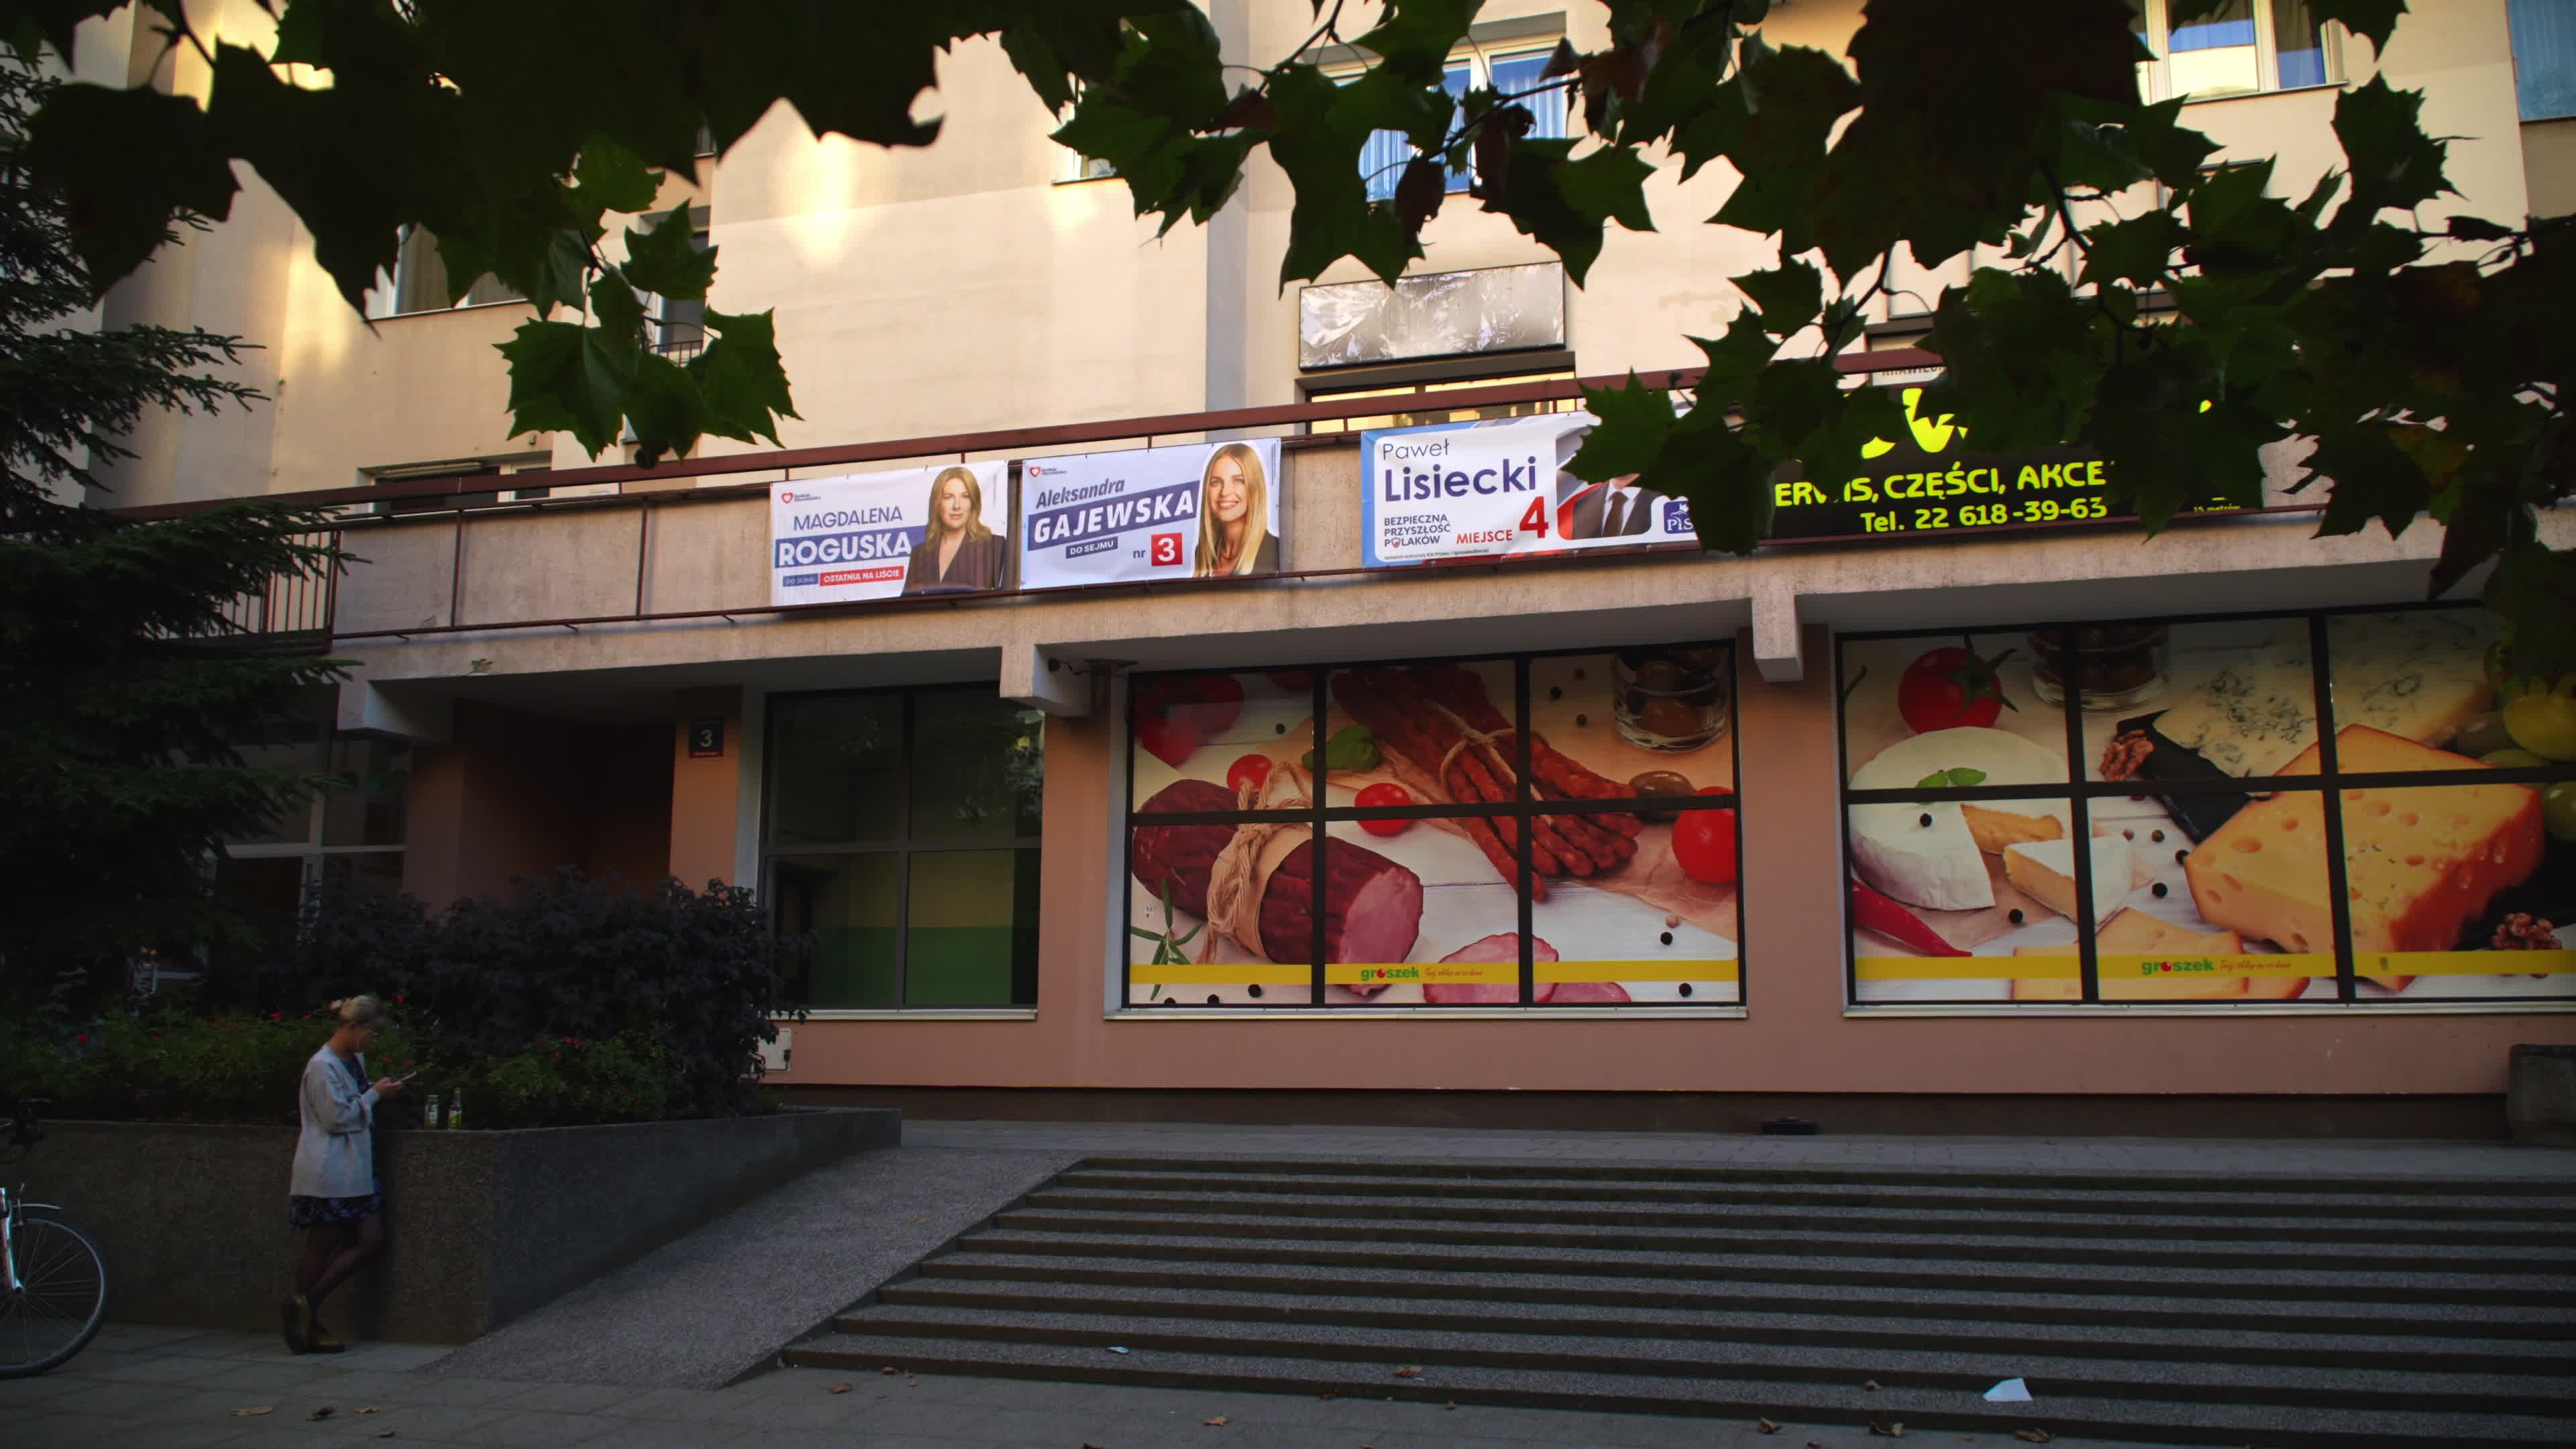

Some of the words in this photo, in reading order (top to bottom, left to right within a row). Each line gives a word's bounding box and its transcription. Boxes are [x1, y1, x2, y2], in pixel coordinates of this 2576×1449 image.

[1383, 438, 1450, 460] Paweł
[1385, 456, 1536, 502] Lisiecki
[1884, 461, 2006, 500] CZĘŚCI,
[2017, 461, 2108, 490] AKCE
[1035, 478, 1125, 510] Aleksandra
[794, 505, 903, 531] MAGDALENA
[1034, 489, 1194, 543] GAJEWSKA
[1384, 514, 1448, 527] BEZPIECZNA
[1519, 496, 1549, 539] 4
[1667, 517, 1693, 531] PiS
[1860, 511, 1905, 533] Tel.
[1915, 507, 1949, 529] 22
[1384, 522, 1451, 537] PRZYSZŁOŚĆ
[1456, 530, 1513, 545] MIEJSCE
[778, 531, 912, 568] ROGUSKA
[1070, 547, 1083, 555] DO
[1084, 540, 1114, 552] SEJMU
[1132, 549, 1146, 559] nr
[1157, 537, 1176, 562] 3
[823, 573, 861, 583] OSTATNIA
[863, 572, 873, 580] NA
[700, 729, 713, 747] 3
[1360, 965, 1419, 981] groszek
[2141, 957, 2216, 975] groszek
